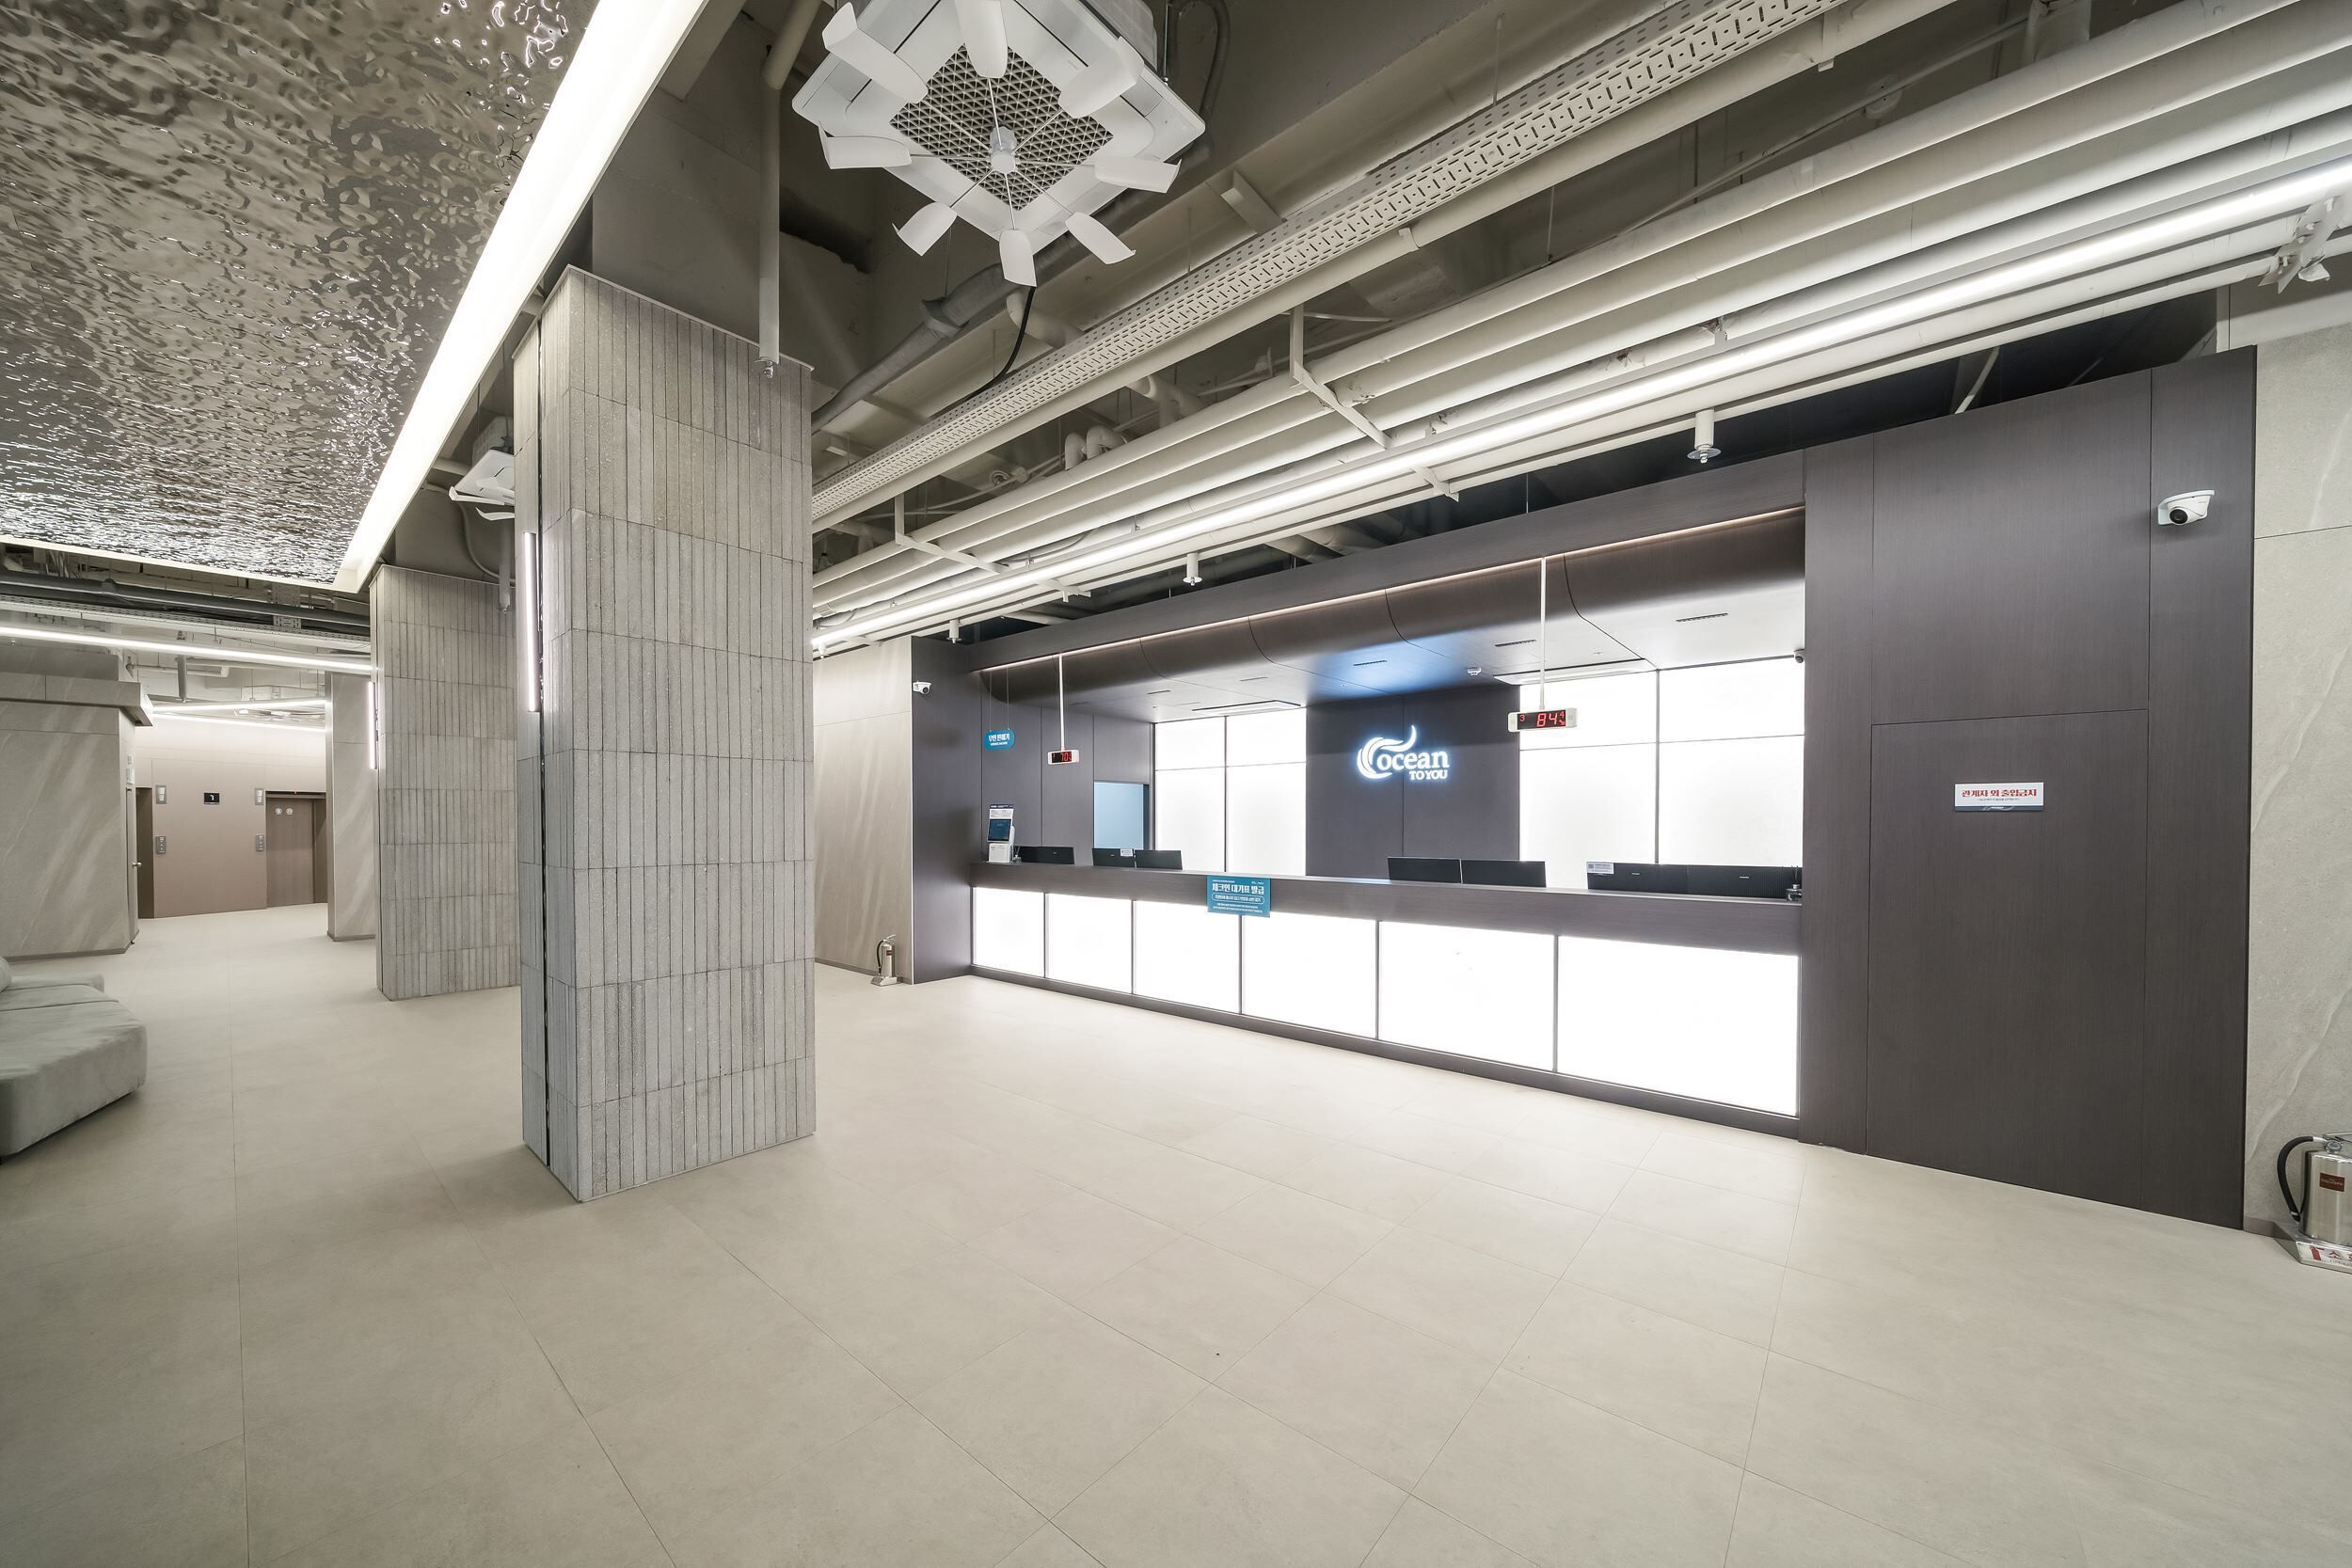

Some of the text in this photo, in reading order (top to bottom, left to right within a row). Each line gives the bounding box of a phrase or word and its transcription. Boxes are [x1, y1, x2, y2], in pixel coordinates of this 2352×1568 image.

[1536, 712, 1558, 727] 84
[1212, 883, 1264, 895] 체크인 대기표 발급
